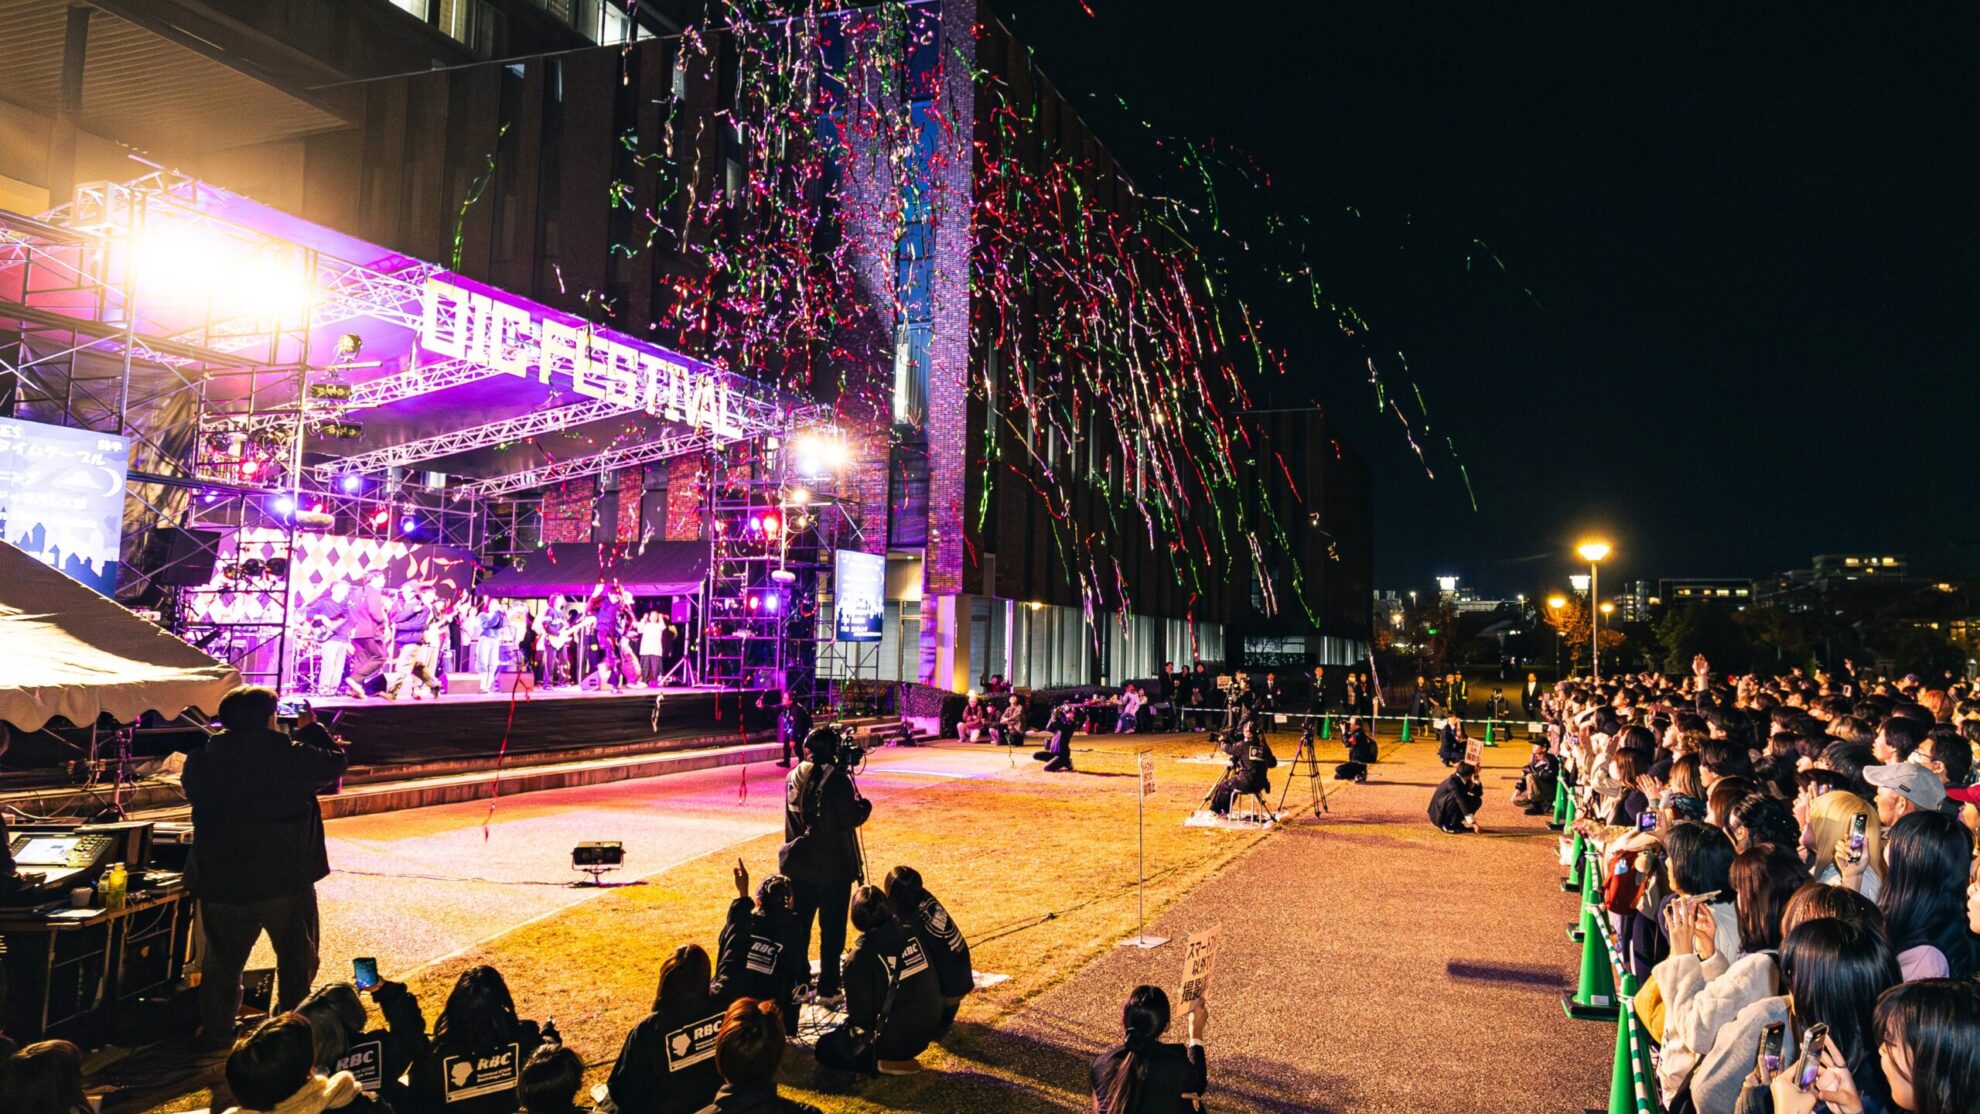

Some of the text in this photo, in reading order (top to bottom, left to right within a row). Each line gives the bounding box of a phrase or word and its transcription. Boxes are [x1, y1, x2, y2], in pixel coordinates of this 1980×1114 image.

[539, 317, 744, 439] FESTIVAL
[694, 1020, 723, 1040] RBC
[336, 1050, 374, 1072] RBC
[477, 1052, 512, 1071] RBC
